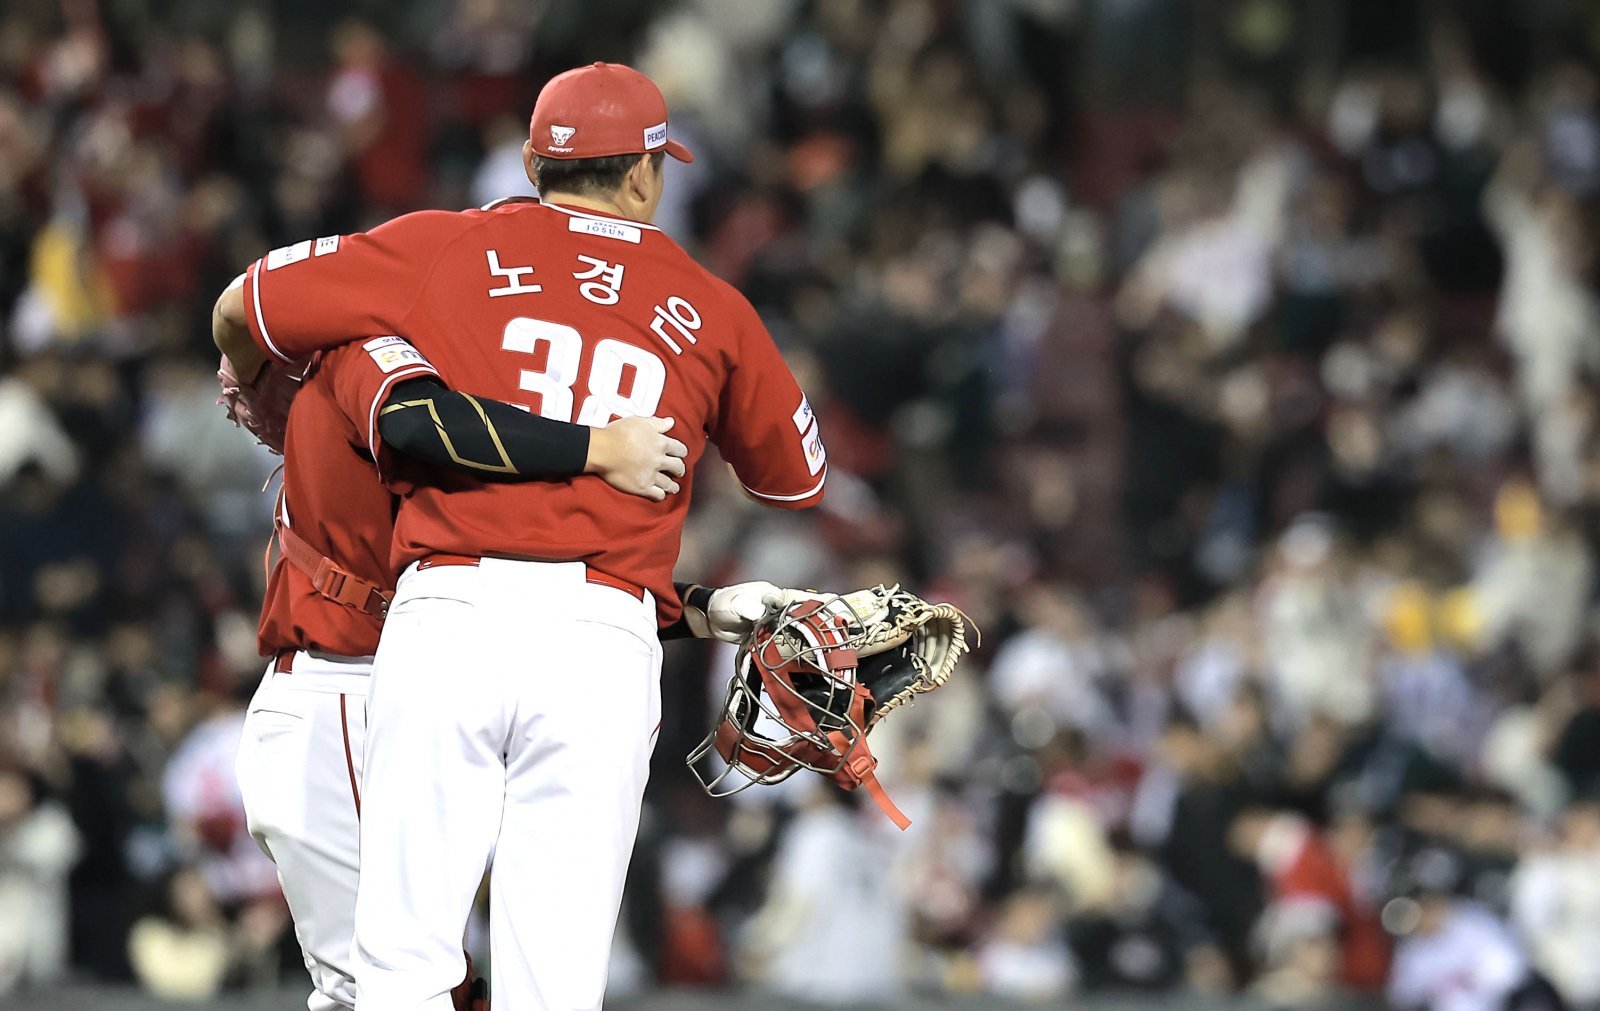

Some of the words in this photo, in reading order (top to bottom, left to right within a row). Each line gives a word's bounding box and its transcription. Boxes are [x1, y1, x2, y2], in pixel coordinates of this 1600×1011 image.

[586, 224, 625, 237] JOSUN
[486, 249, 702, 356] 노경은
[502, 317, 667, 429] 38
